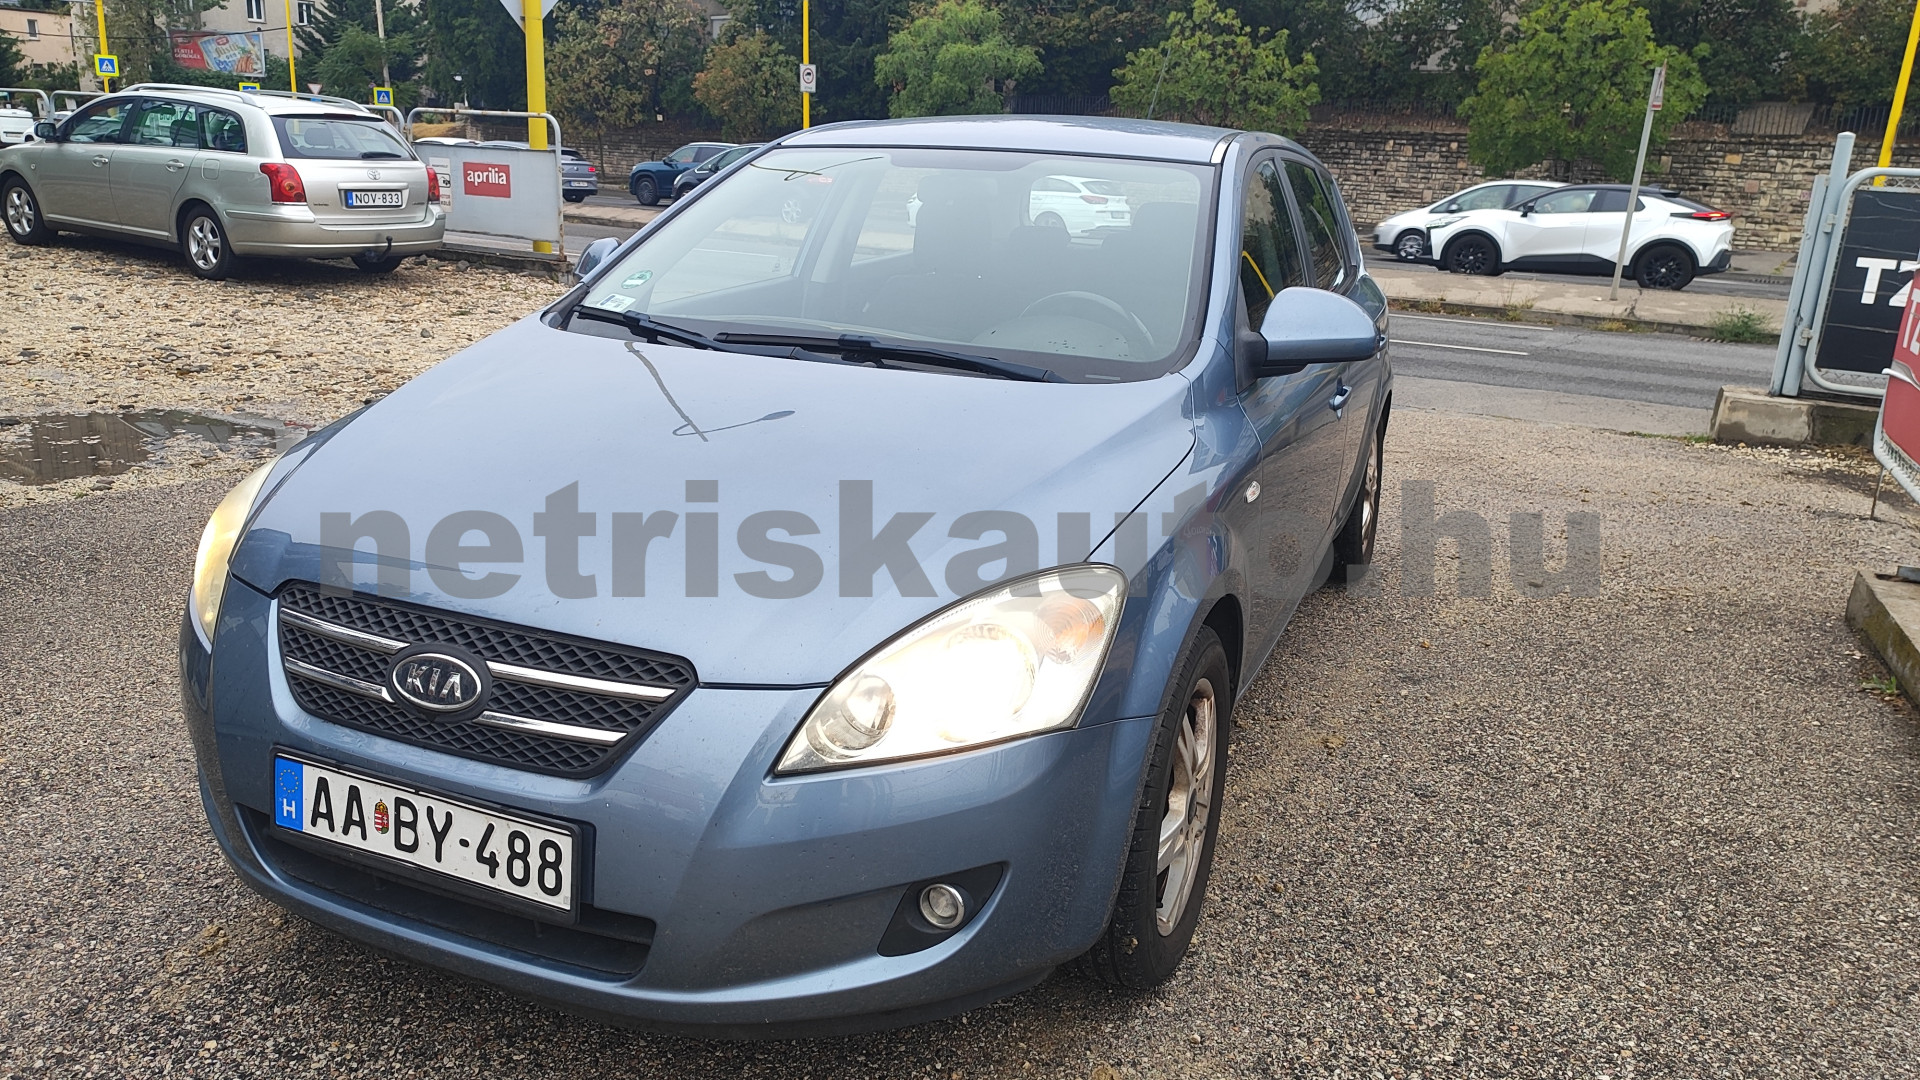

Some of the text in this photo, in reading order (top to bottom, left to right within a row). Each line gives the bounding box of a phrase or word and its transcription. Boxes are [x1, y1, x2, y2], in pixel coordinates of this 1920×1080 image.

[467, 167, 507, 187] aprilia
[355, 193, 400, 204] NOV-833
[405, 662, 462, 702] KIA
[282, 776, 563, 897] H AA BY-488
